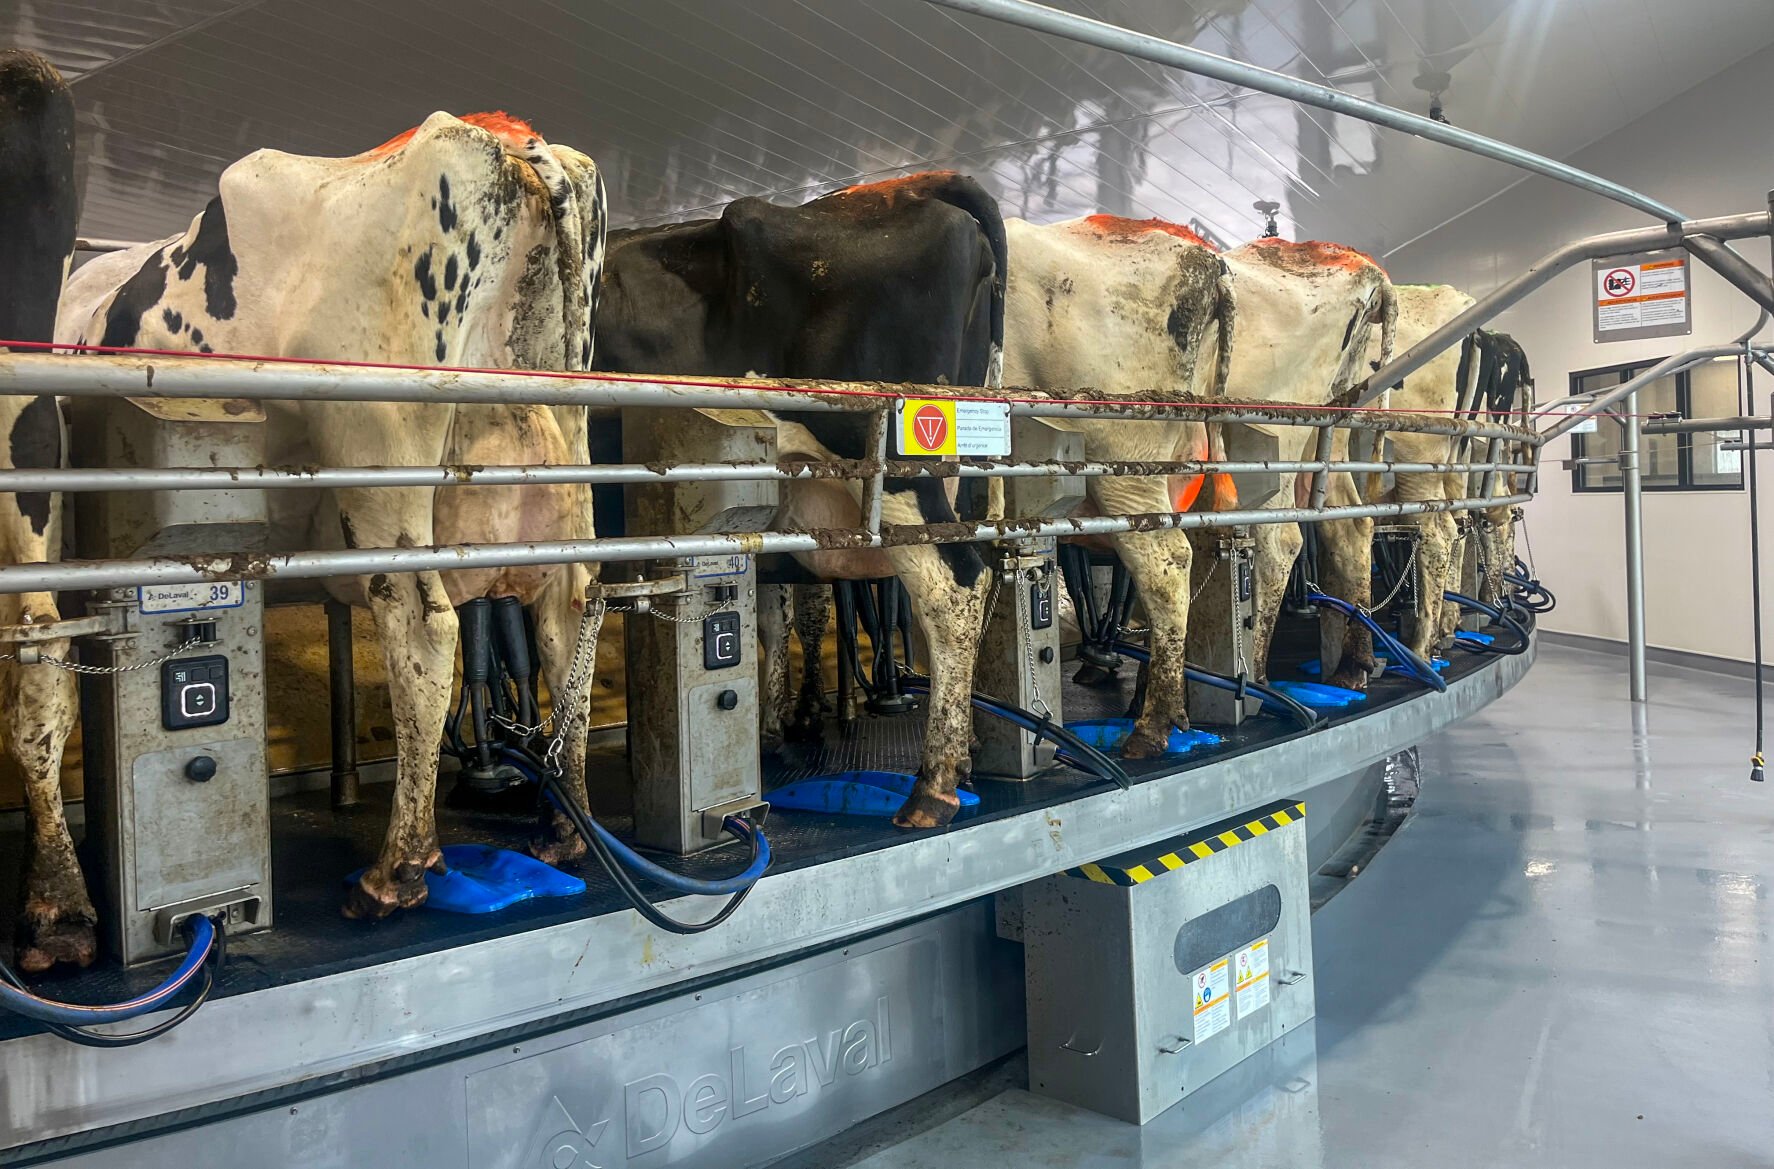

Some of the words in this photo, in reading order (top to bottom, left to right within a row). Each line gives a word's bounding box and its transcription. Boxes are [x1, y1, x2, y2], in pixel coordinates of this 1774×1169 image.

[727, 556, 739, 568] 40
[158, 591, 189, 600] DeLaval
[209, 585, 229, 601] 39
[624, 995, 892, 1160] DeLaval
